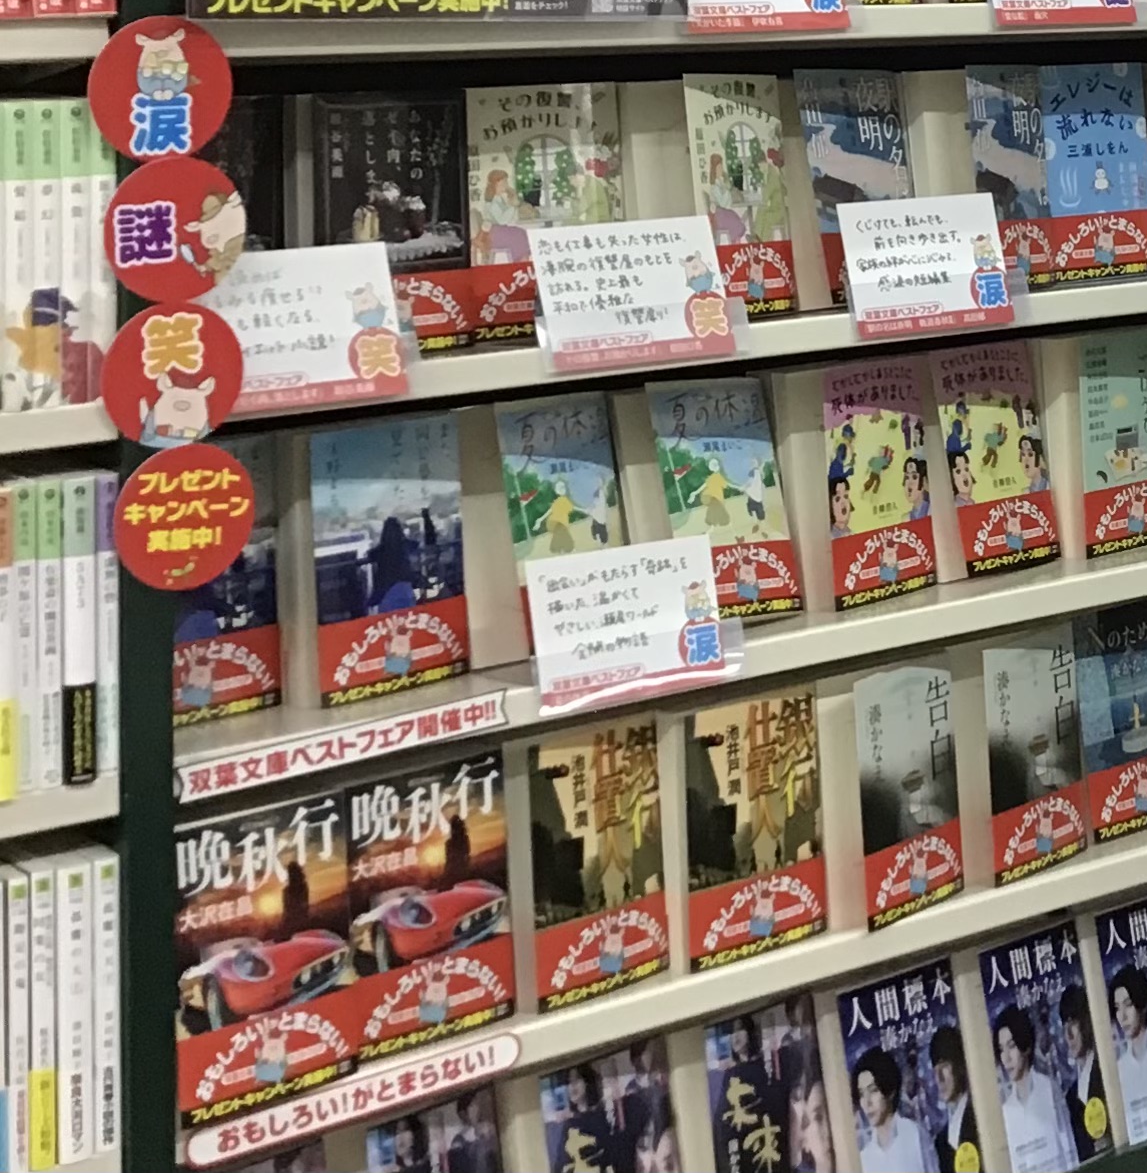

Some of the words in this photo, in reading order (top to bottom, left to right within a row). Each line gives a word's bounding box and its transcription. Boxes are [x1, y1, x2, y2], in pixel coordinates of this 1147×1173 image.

[1050, 75, 1136, 114] エレジーは
[131, 94, 191, 154] 涙
[1055, 107, 1134, 142] 流れない
[1067, 139, 1129, 159] 三浦しをん
[115, 202, 176, 267] 謎
[975, 272, 1010, 309] 涙
[690, 297, 729, 338] 笑
[142, 312, 204, 379] 笑
[356, 334, 402, 380] 笑
[138, 468, 241, 495] プレゼント
[123, 497, 250, 524] キャンペーン
[685, 624, 722, 665] 涙
[188, 700, 496, 796] 双葉文庫ベストフェア開催中!!
[350, 756, 501, 848] 晩秋行
[175, 798, 340, 901] 晩秋行
[987, 929, 1078, 996] 人間標本
[847, 967, 952, 1039] 人間標本
[216, 1046, 496, 1153] おもしろい!がとまらない!
